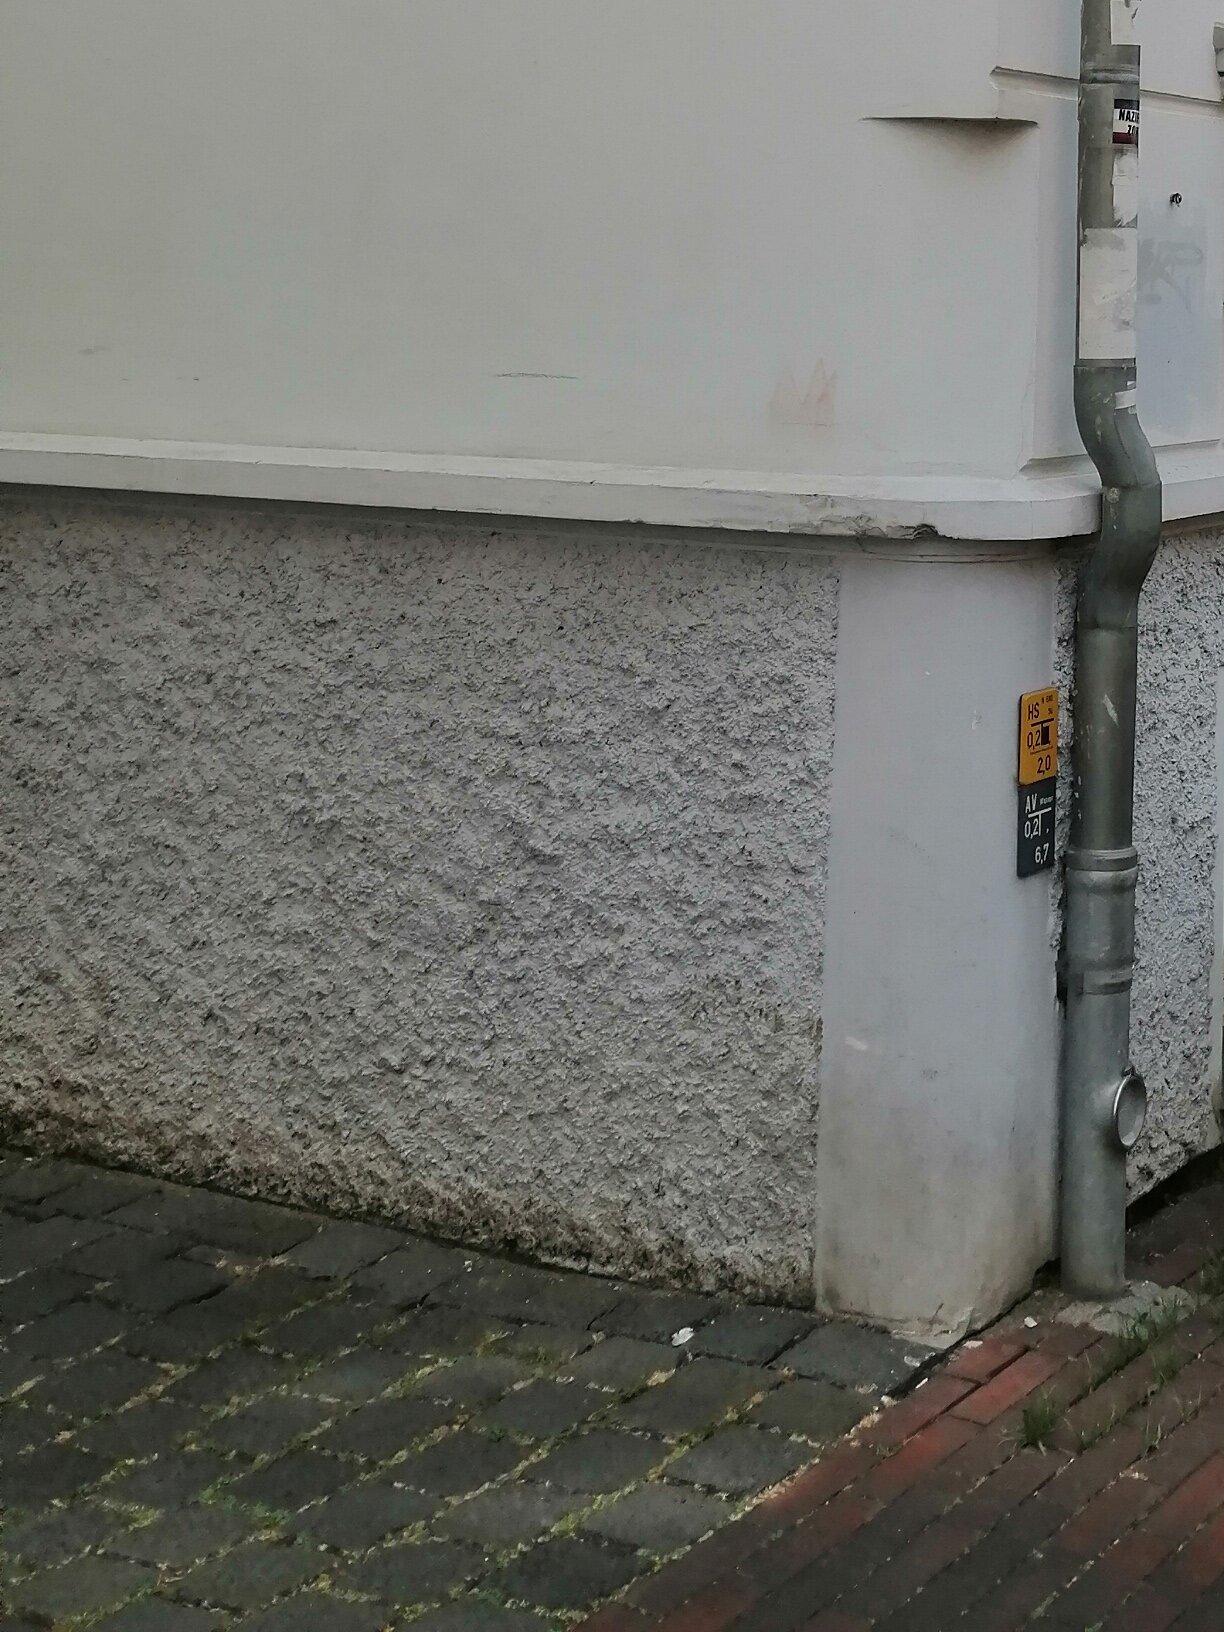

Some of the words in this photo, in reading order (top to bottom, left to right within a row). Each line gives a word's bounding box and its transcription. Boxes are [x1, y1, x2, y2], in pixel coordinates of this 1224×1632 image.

[1027, 702, 1040, 721] HS
[1026, 729, 1041, 750] 0,2
[1036, 754, 1051, 775] 2,0
[1025, 793, 1038, 814] AV
[1024, 818, 1039, 839] 0,2
[1035, 842, 1049, 865] 6,7
